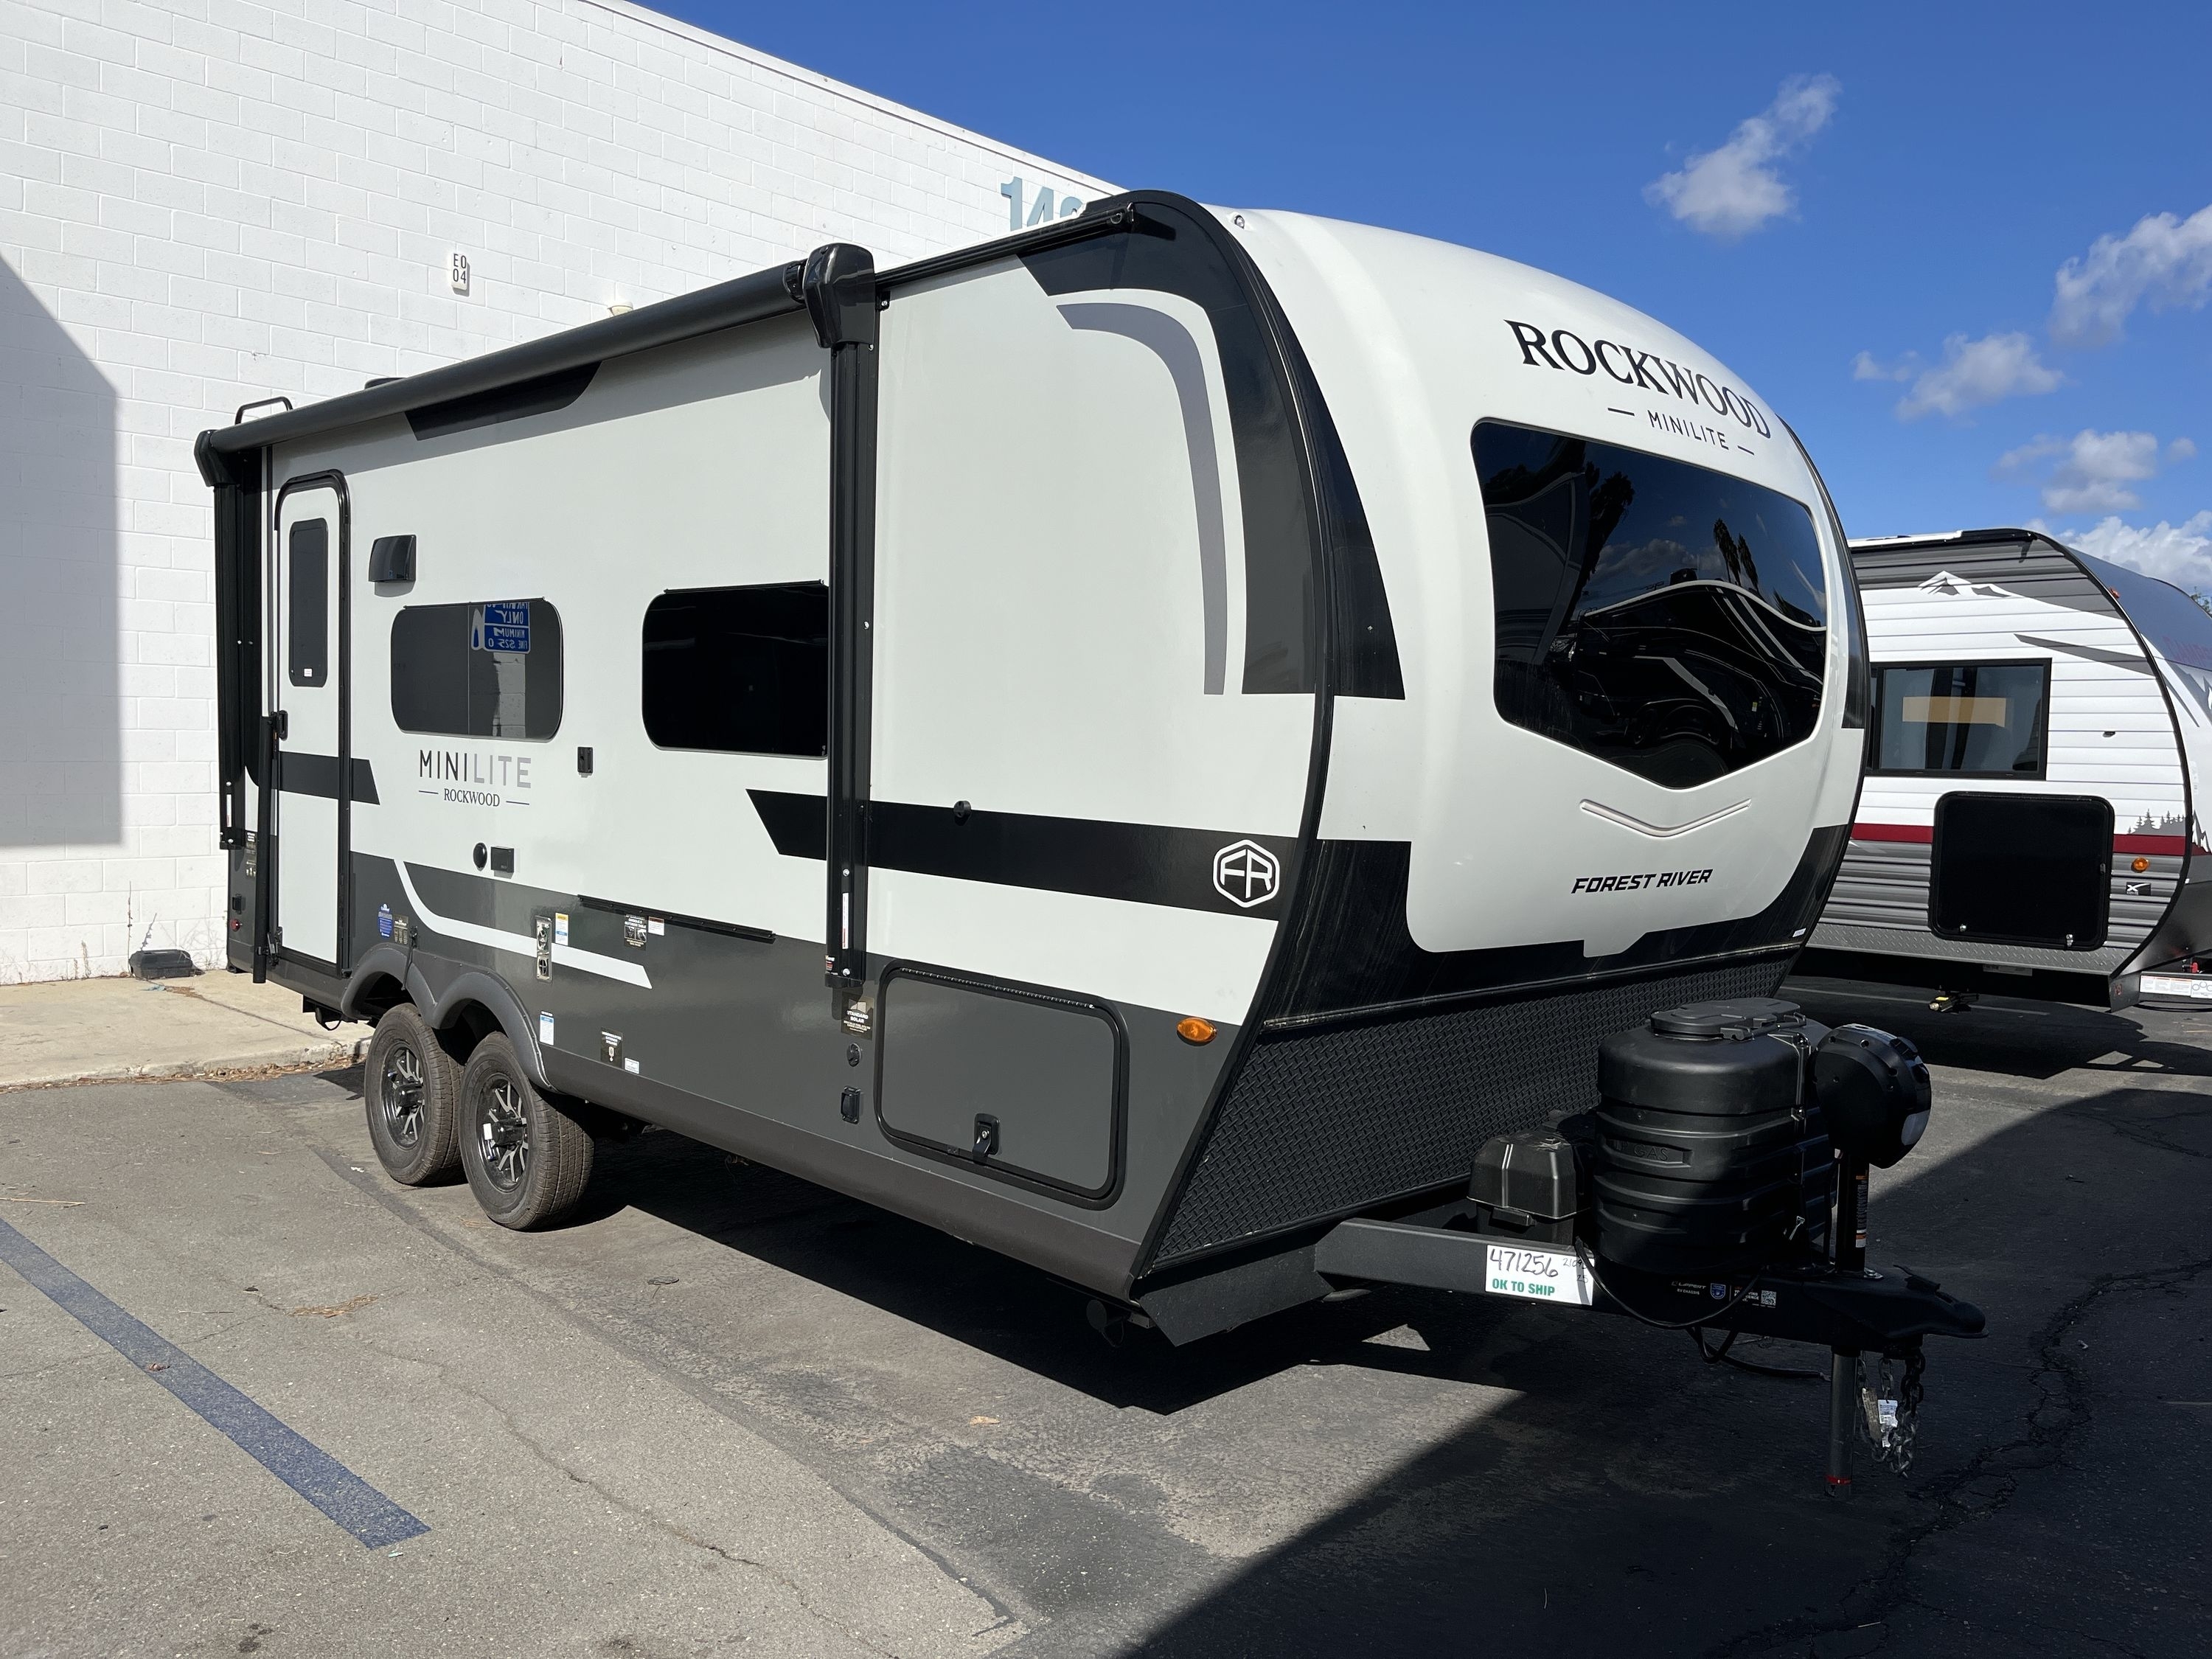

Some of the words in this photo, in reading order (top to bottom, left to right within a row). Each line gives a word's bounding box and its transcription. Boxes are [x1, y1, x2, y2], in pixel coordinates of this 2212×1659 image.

[1503, 319, 1771, 439] ROCKWOOD
[1647, 409, 1729, 451] MINILITE
[419, 749, 532, 790] MINILITE
[443, 788, 501, 808] ROCKWOOD
[1571, 873, 1657, 894] FOREST
[1656, 869, 1714, 888] RIVER
[1634, 1144, 1669, 1162] GAS
[1489, 1248, 1559, 1278] 471256
[1492, 1278, 1509, 1290] OK
[1511, 1280, 1525, 1293] TO
[1528, 1283, 1555, 1296] SHIP
